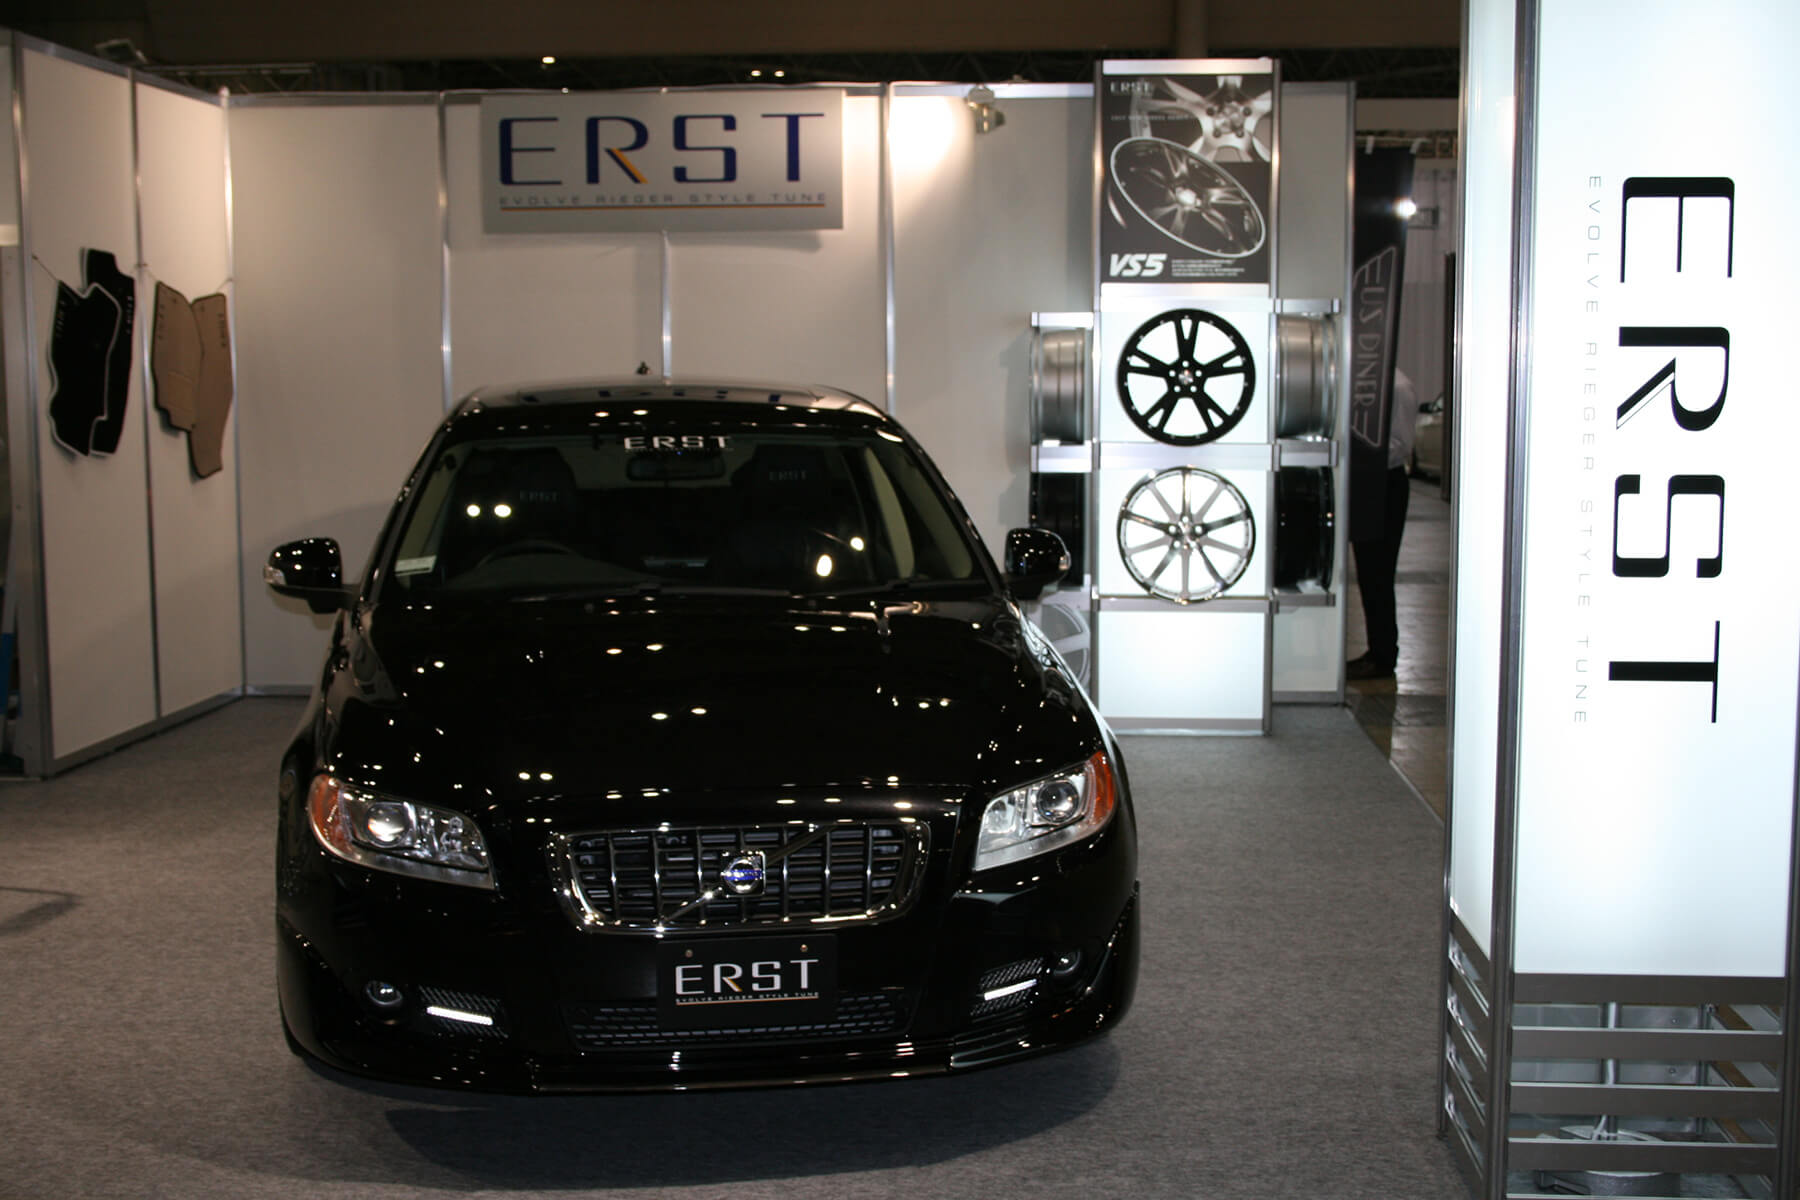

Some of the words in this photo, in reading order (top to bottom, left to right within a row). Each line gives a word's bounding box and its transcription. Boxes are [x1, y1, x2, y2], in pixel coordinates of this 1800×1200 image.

[499, 113, 825, 186] ERST
[500, 194, 580, 206] EVOLVE
[595, 193, 673, 204] RIEGER
[689, 192, 755, 203] STYLE
[770, 191, 825, 203] TUNE
[1109, 253, 1168, 278] VS5
[1585, 175, 1601, 313] EVOLVE
[1353, 333, 1382, 408] DINER
[1581, 341, 1598, 471] RIEGER
[623, 435, 732, 450] ERST
[1607, 176, 1735, 723] ERST
[1577, 499, 1593, 608] STYLE
[1573, 634, 1590, 723] TUNE
[675, 958, 819, 996] ERST
